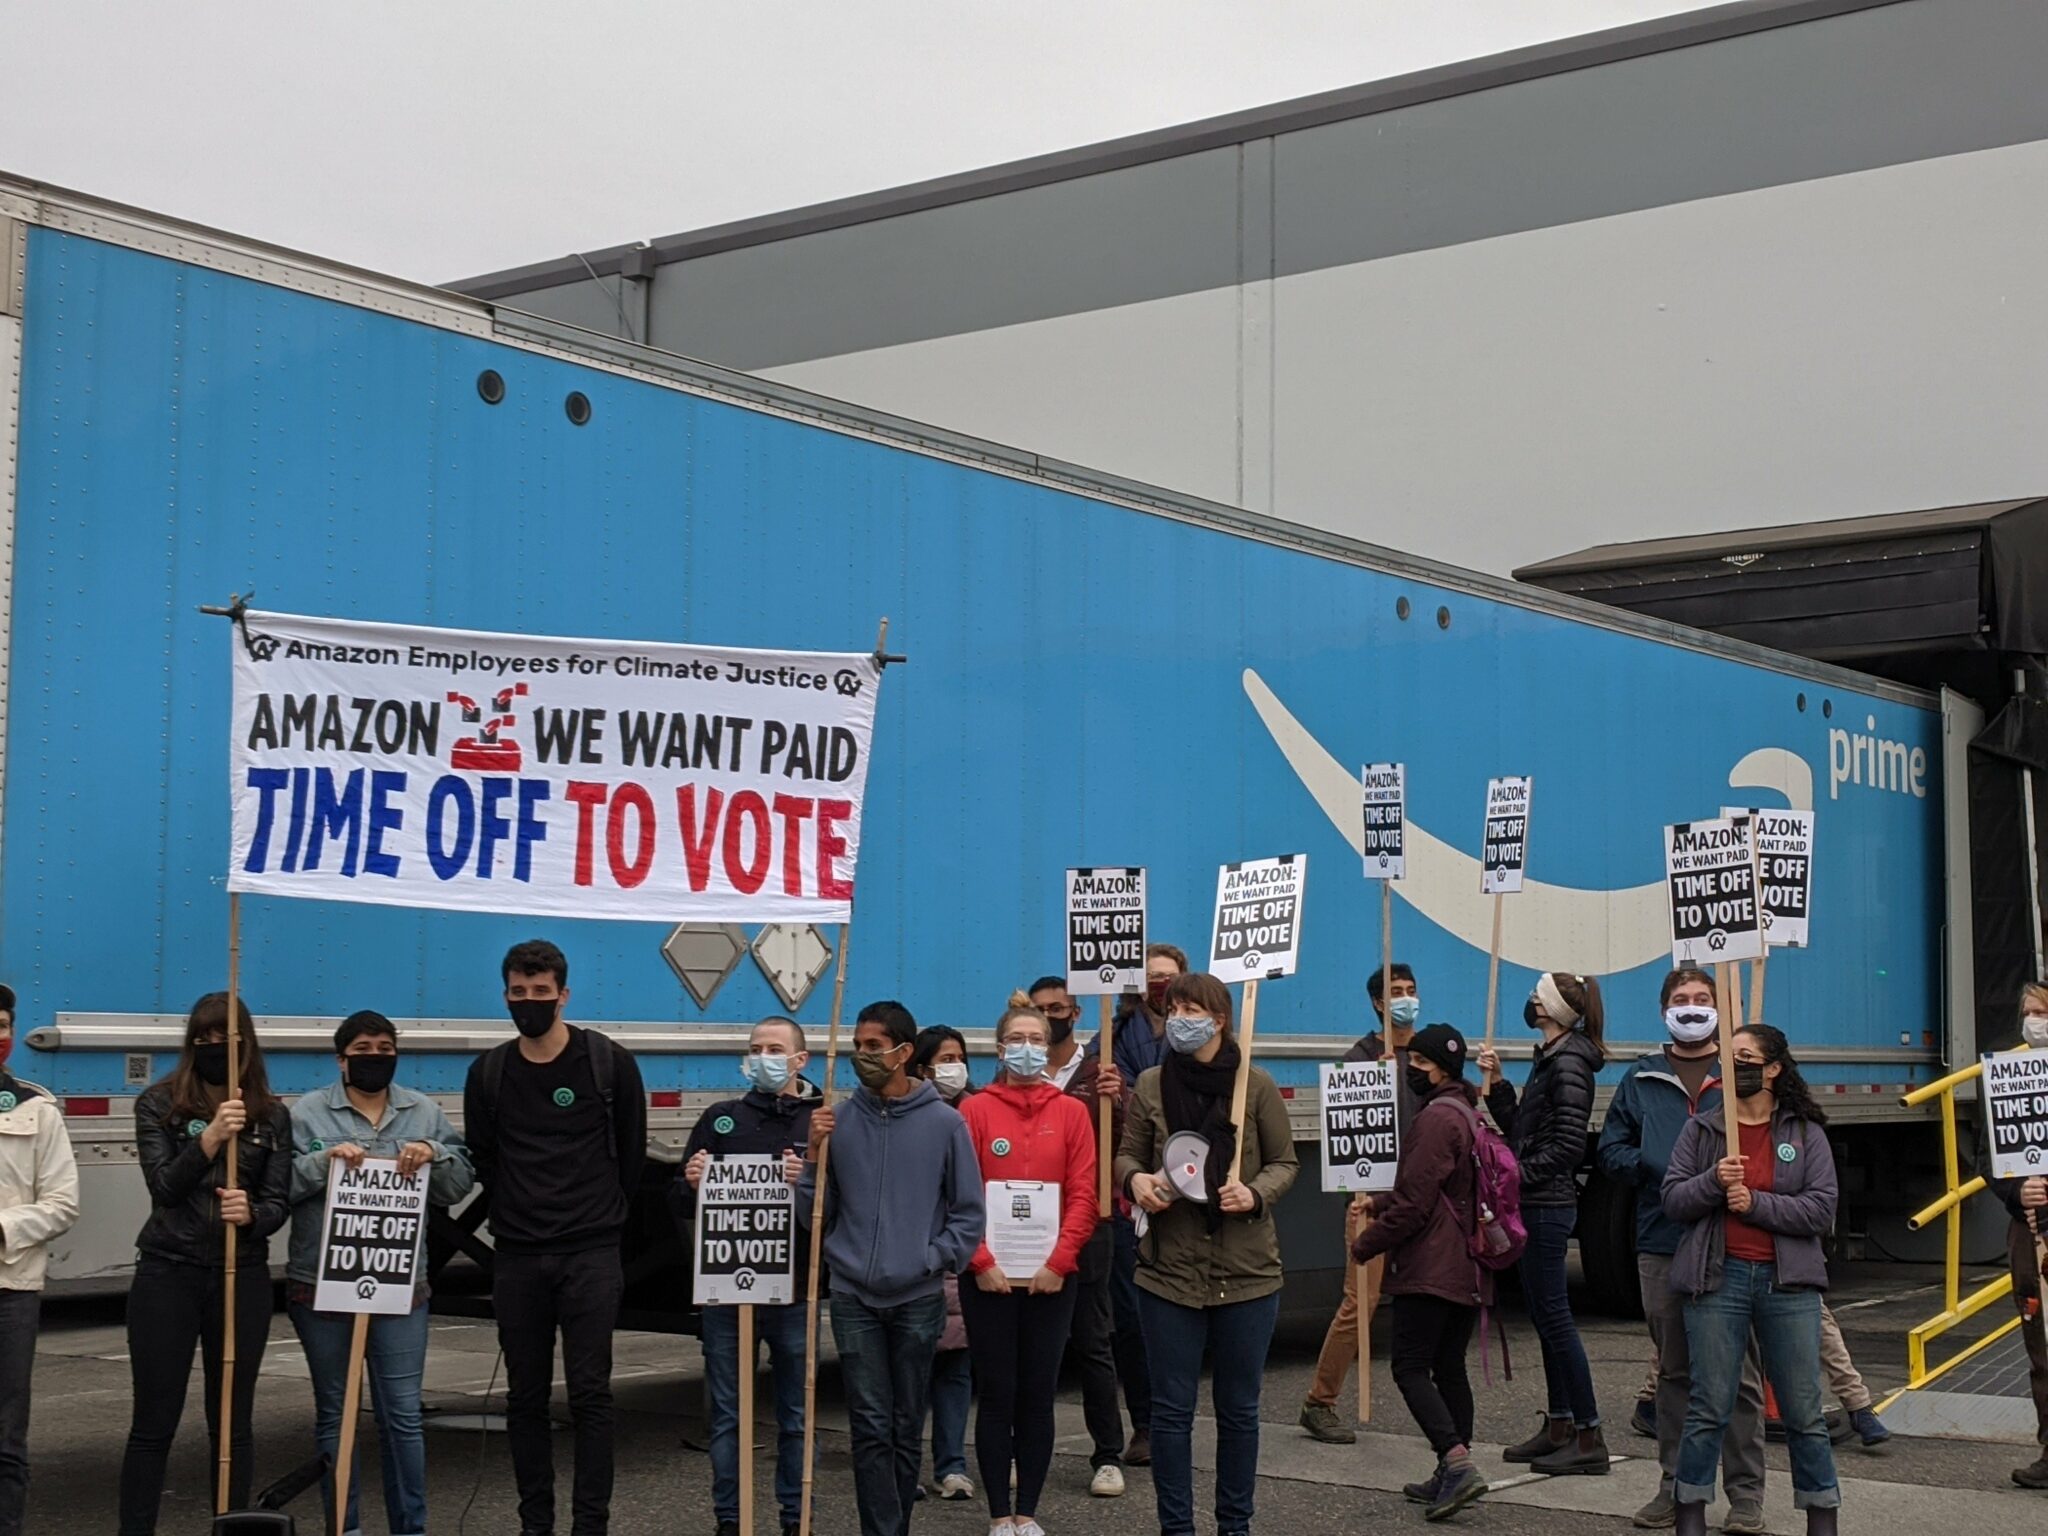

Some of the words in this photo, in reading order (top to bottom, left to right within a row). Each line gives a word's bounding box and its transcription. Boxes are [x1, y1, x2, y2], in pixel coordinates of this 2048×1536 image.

[284, 639, 401, 668] Amazon
[407, 645, 560, 678] Employees
[566, 654, 607, 675] for
[613, 656, 718, 683] Climate
[726, 660, 828, 691] Justice
[247, 692, 440, 757] AMAZON
[533, 705, 606, 765] WE
[618, 709, 751, 775] WANT
[761, 719, 858, 782] PAID
[1829, 713, 1927, 800] prime
[1365, 807, 1384, 824] TIME
[1385, 806, 1400, 823] OFF
[244, 767, 407, 878] TIME
[427, 775, 550, 883] OFF
[564, 780, 656, 888] TO
[676, 781, 855, 900] VOTE
[1366, 830, 1378, 848] TO
[1379, 829, 1401, 848] VOTE
[1488, 820, 1507, 839] TIME
[1507, 819, 1524, 837] OFF
[1671, 827, 1748, 854] AMAZON:
[1783, 840, 1807, 852] PAID
[1486, 844, 1497, 863] TO
[1499, 842, 1522, 862] VOTE
[1672, 857, 1690, 870] WE
[1692, 852, 1725, 867] WANT
[1726, 848, 1749, 863] PAID
[1225, 866, 1297, 889] AMAZON:
[1773, 858, 1805, 880] OFF
[1072, 877, 1140, 895] AMAZON:
[1224, 890, 1240, 902] WE
[1242, 886, 1271, 899] WANT
[1273, 883, 1295, 895] PAID
[1674, 873, 1717, 899] TIME
[1720, 868, 1751, 893] OFF
[1072, 898, 1087, 908] WE
[1090, 897, 1118, 908] WANT
[1120, 896, 1140, 907] PAID
[1222, 904, 1260, 926] TIME
[1263, 899, 1294, 920] OFF
[1072, 915, 1110, 935] TIME
[1113, 914, 1140, 933] OFF
[1676, 905, 1702, 929] TO
[1705, 898, 1754, 926] VOTE
[1219, 930, 1242, 951] TO
[1246, 923, 1291, 948] VOTE
[1072, 941, 1095, 961] TO
[1098, 940, 1140, 961] VOTE
[1327, 1070, 1391, 1089] AMAZON:
[1991, 1082, 2007, 1094] WE
[2008, 1080, 2036, 1092] WANT
[2038, 1079, 2048, 1089] PA
[1328, 1092, 1342, 1103] WE
[1344, 1090, 1370, 1102] WANT
[1372, 1089, 1392, 1100] PAID
[1329, 1109, 1364, 1129] TIME
[1366, 1107, 1392, 1127] OFF
[1993, 1097, 2031, 1119] TIME
[1330, 1135, 1351, 1156] TO
[1354, 1132, 1394, 1155] VOTE
[1996, 1123, 2019, 1145] TO
[339, 1168, 422, 1192] AMAZON:
[337, 1191, 357, 1205] WE
[359, 1193, 393, 1207] WANT
[395, 1196, 420, 1209] PAID
[706, 1188, 724, 1200] WE
[727, 1188, 761, 1200] WANT
[764, 1188, 789, 1200] PAID
[334, 1213, 381, 1239] TIME
[382, 1216, 416, 1241] OFF
[705, 1209, 750, 1232] TIME
[754, 1209, 788, 1231] OFF
[330, 1244, 357, 1270] TO
[361, 1246, 412, 1274] VOTE
[704, 1239, 731, 1264] TO
[735, 1238, 787, 1264] VOTE
